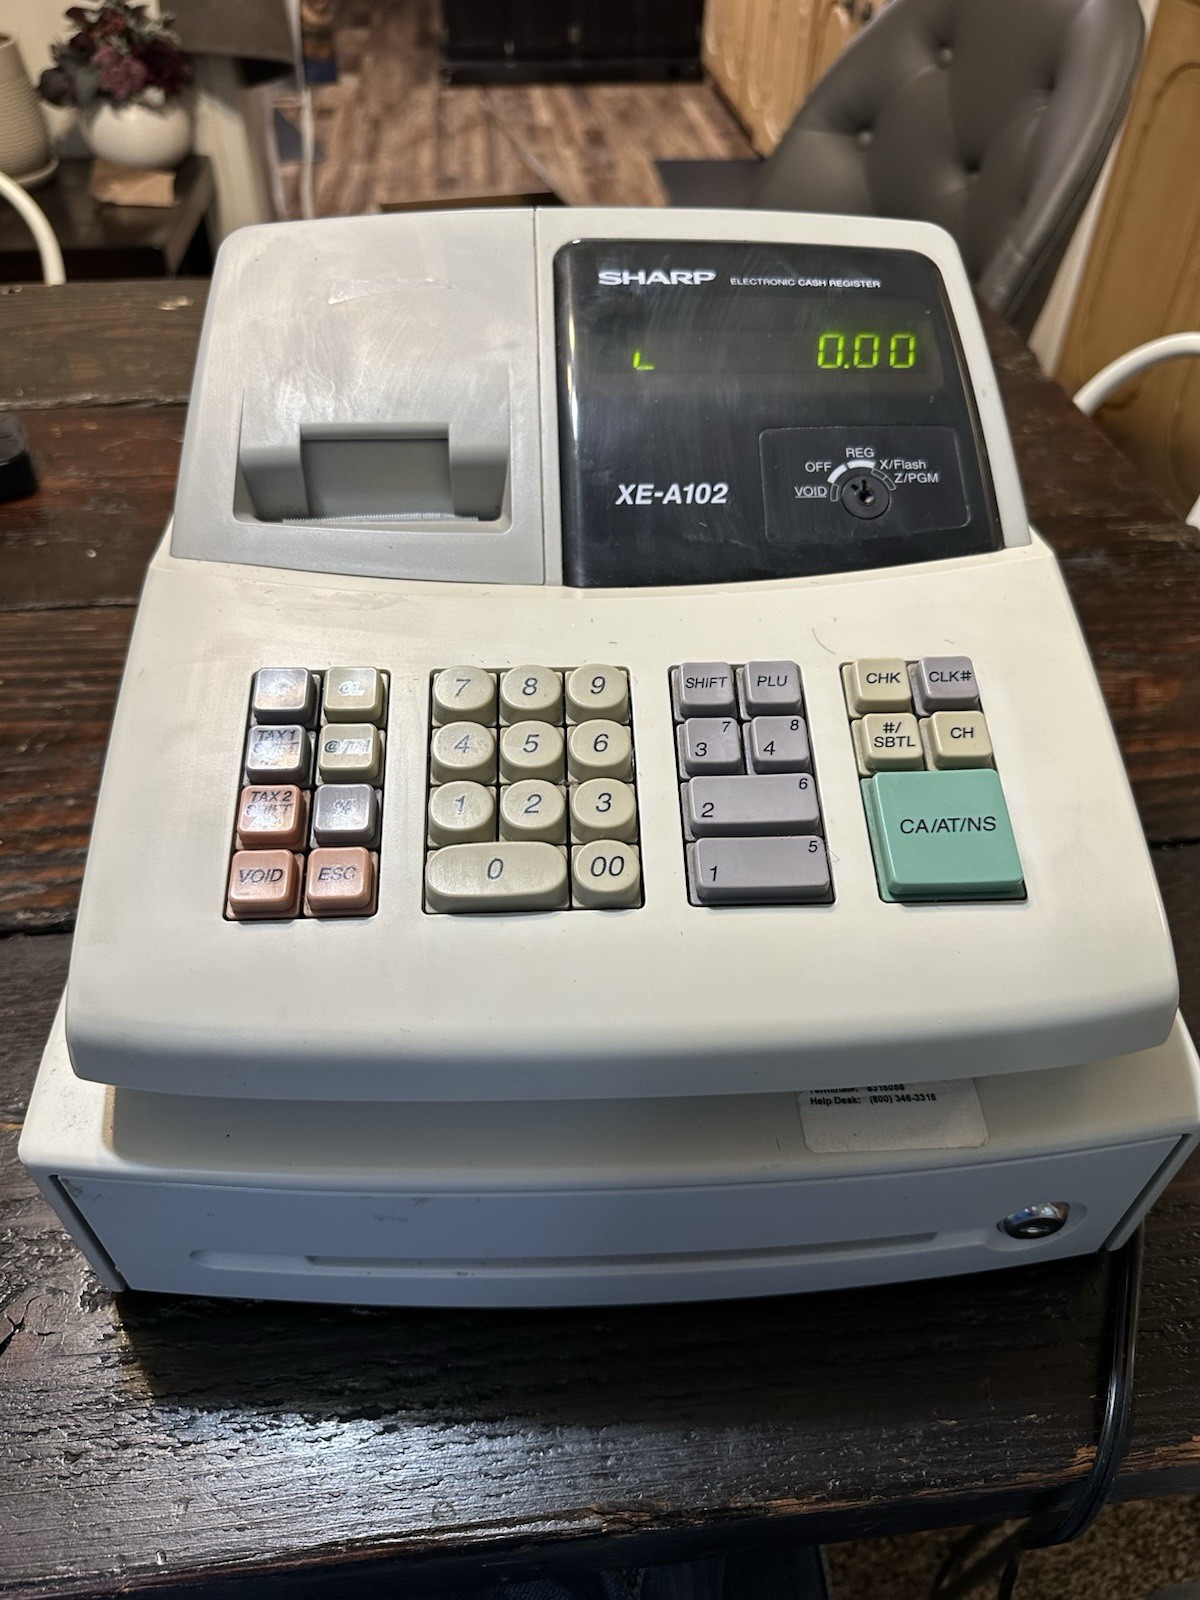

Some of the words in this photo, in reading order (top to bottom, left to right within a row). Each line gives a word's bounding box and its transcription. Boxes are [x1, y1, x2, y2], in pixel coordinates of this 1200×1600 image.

[598, 270, 717, 286] SHARP
[730, 277, 796, 288] ELECTRONIC
[798, 278, 827, 288] CASH
[829, 278, 881, 289] REGISTER
[816, 333, 916, 369] 0.00
[846, 447, 874, 459] REG
[805, 461, 832, 473] OFF
[879, 459, 927, 470] X/Flash
[894, 473, 939, 484] Z/PGM
[615, 483, 729, 506] XE-A102
[794, 486, 828, 498] VOID
[685, 675, 728, 689] SHIFT
[756, 675, 788, 687] PLU
[866, 671, 901, 685] CHK
[928, 670, 972, 683] CLK#
[454, 678, 471, 697] 7
[521, 677, 538, 696] 8
[590, 676, 606, 695] 9
[722, 721, 731, 732] 7
[790, 719, 799, 731] 8
[882, 721, 902, 734] #/
[257, 729, 286, 742] TAX
[290, 729, 297, 741] 1
[950, 727, 974, 739] CH
[454, 734, 471, 754] 4
[522, 733, 540, 753] 5
[593, 733, 609, 752] 6
[763, 741, 776, 756] 4
[873, 735, 916, 748] SBTL
[694, 742, 707, 757] 3
[798, 778, 808, 790] 6
[251, 791, 280, 802] TAX
[281, 790, 293, 802] 2
[596, 792, 612, 813] 3
[454, 795, 466, 815] 1
[524, 794, 542, 814] 2
[701, 802, 714, 818] 2
[900, 815, 997, 835] CA/AT/NS
[808, 840, 818, 853] 5
[316, 866, 357, 881] ESC
[487, 858, 504, 880] 0
[590, 855, 625, 877] 00
[709, 865, 718, 882] 1
[238, 868, 283, 883] VOID
[810, 1096, 832, 1107] Help
[834, 1095, 861, 1105] Desk:
[869, 1094, 893, 1106] (800)
